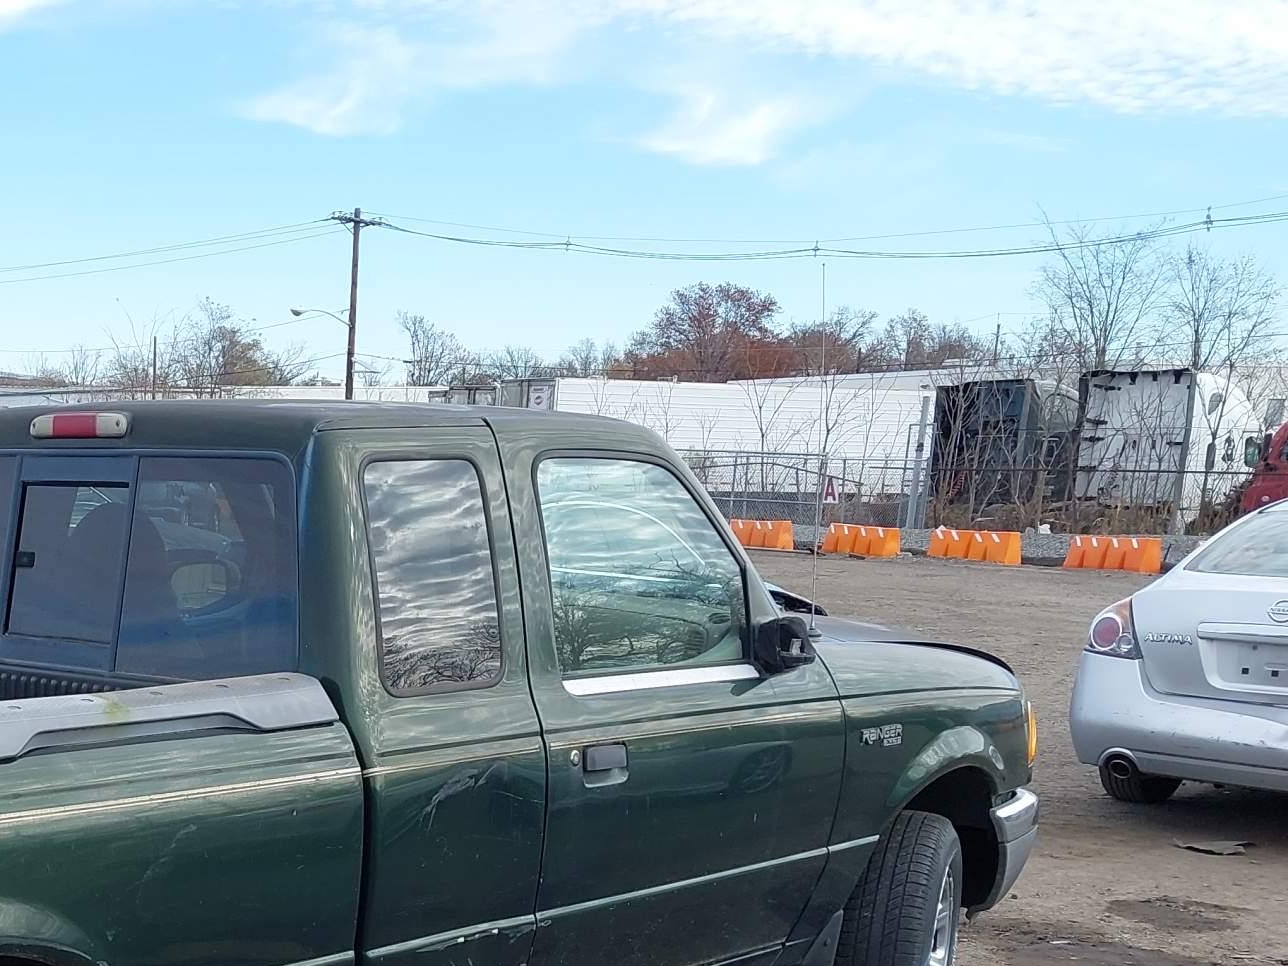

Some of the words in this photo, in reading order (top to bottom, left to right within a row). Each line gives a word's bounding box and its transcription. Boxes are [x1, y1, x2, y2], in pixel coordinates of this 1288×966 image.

[824, 477, 837, 502] A
[1144, 632, 1192, 645] ALTIMA
[860, 723, 903, 745] RANGER
